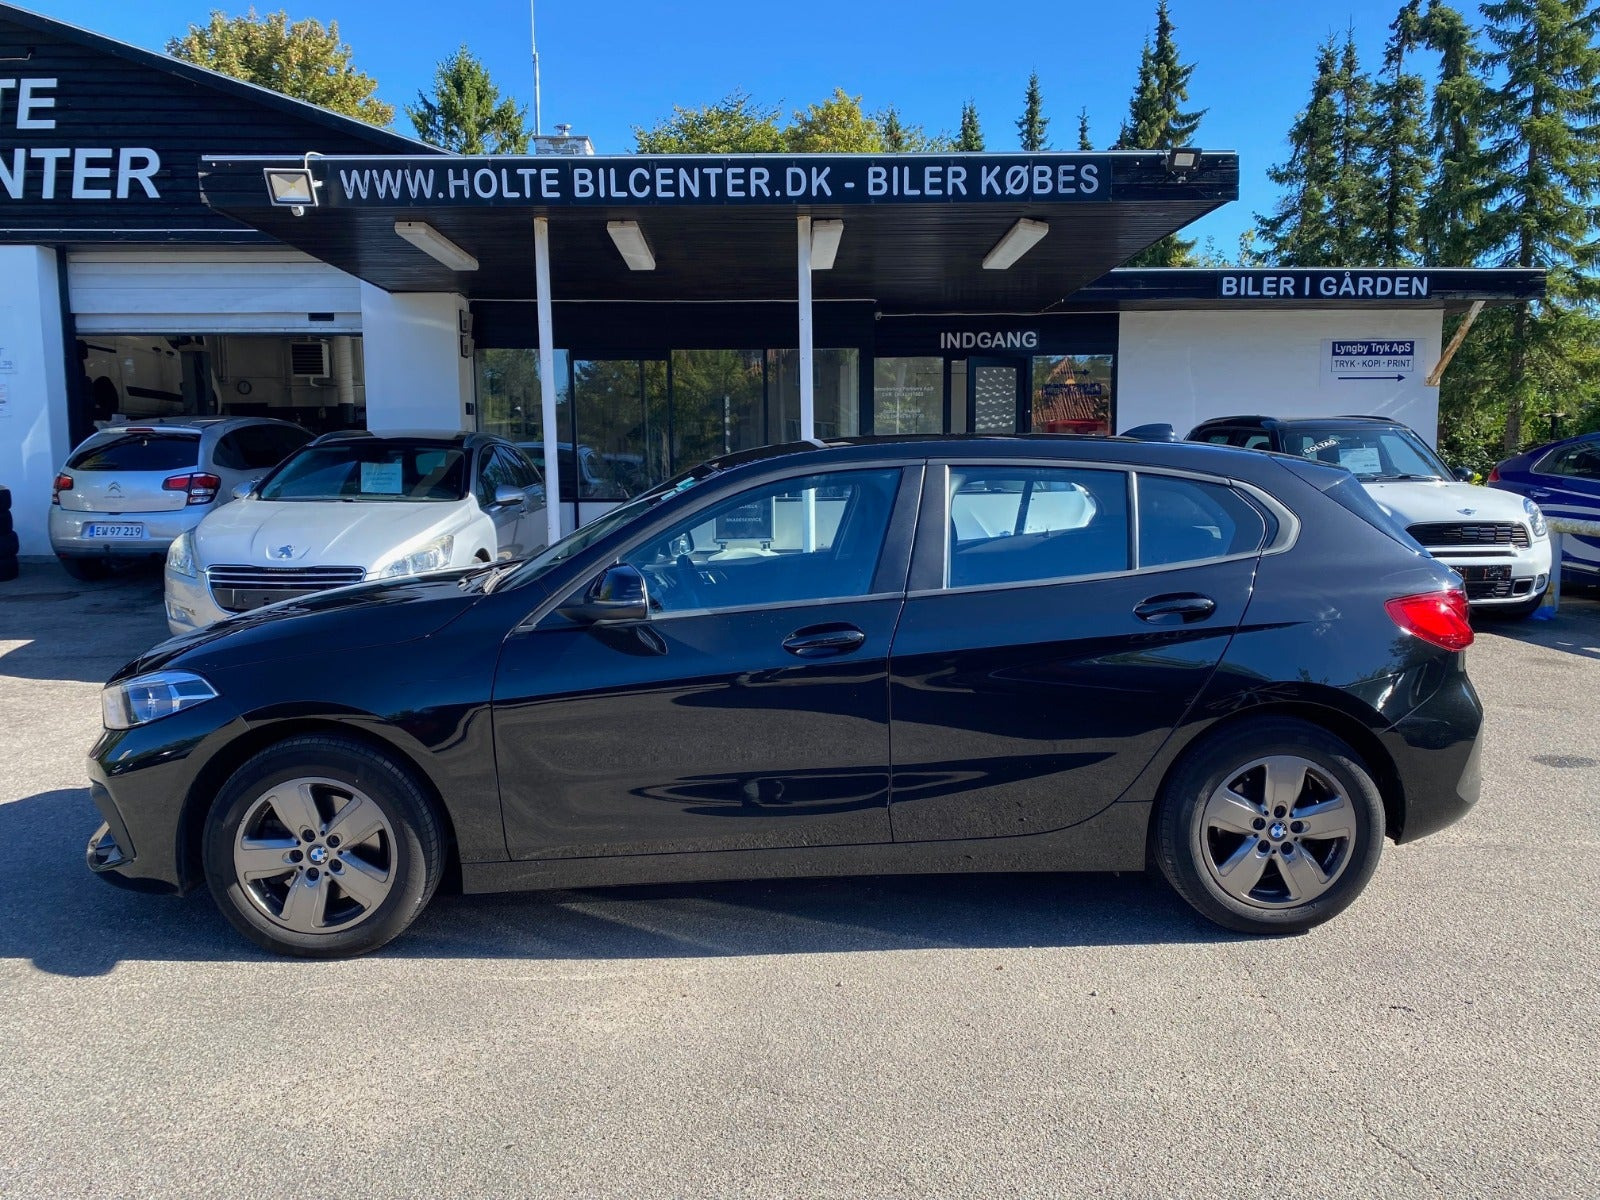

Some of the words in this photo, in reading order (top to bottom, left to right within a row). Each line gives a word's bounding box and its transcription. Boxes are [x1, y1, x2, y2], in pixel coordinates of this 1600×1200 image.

[0, 148, 161, 199] NTER
[340, 169, 559, 199] WWW.HOLTE
[574, 167, 832, 197] BILCENTER.DK
[867, 165, 967, 196] BILER
[981, 164, 1099, 195] KØBES
[1222, 276, 1295, 296] BILER
[1304, 276, 1310, 296] I
[1319, 271, 1428, 296] GÅRDEN
[940, 331, 1037, 349] INDGANG
[1335, 343, 1368, 354] Lyngby
[1371, 343, 1390, 354] Tryk
[1391, 343, 1411, 354] ApS
[1387, 359, 1411, 367] PRINT
[1303, 438, 1338, 455] SOLTAG
[95, 526, 107, 536] EW
[110, 527, 120, 536] 97
[123, 526, 141, 536] 219
